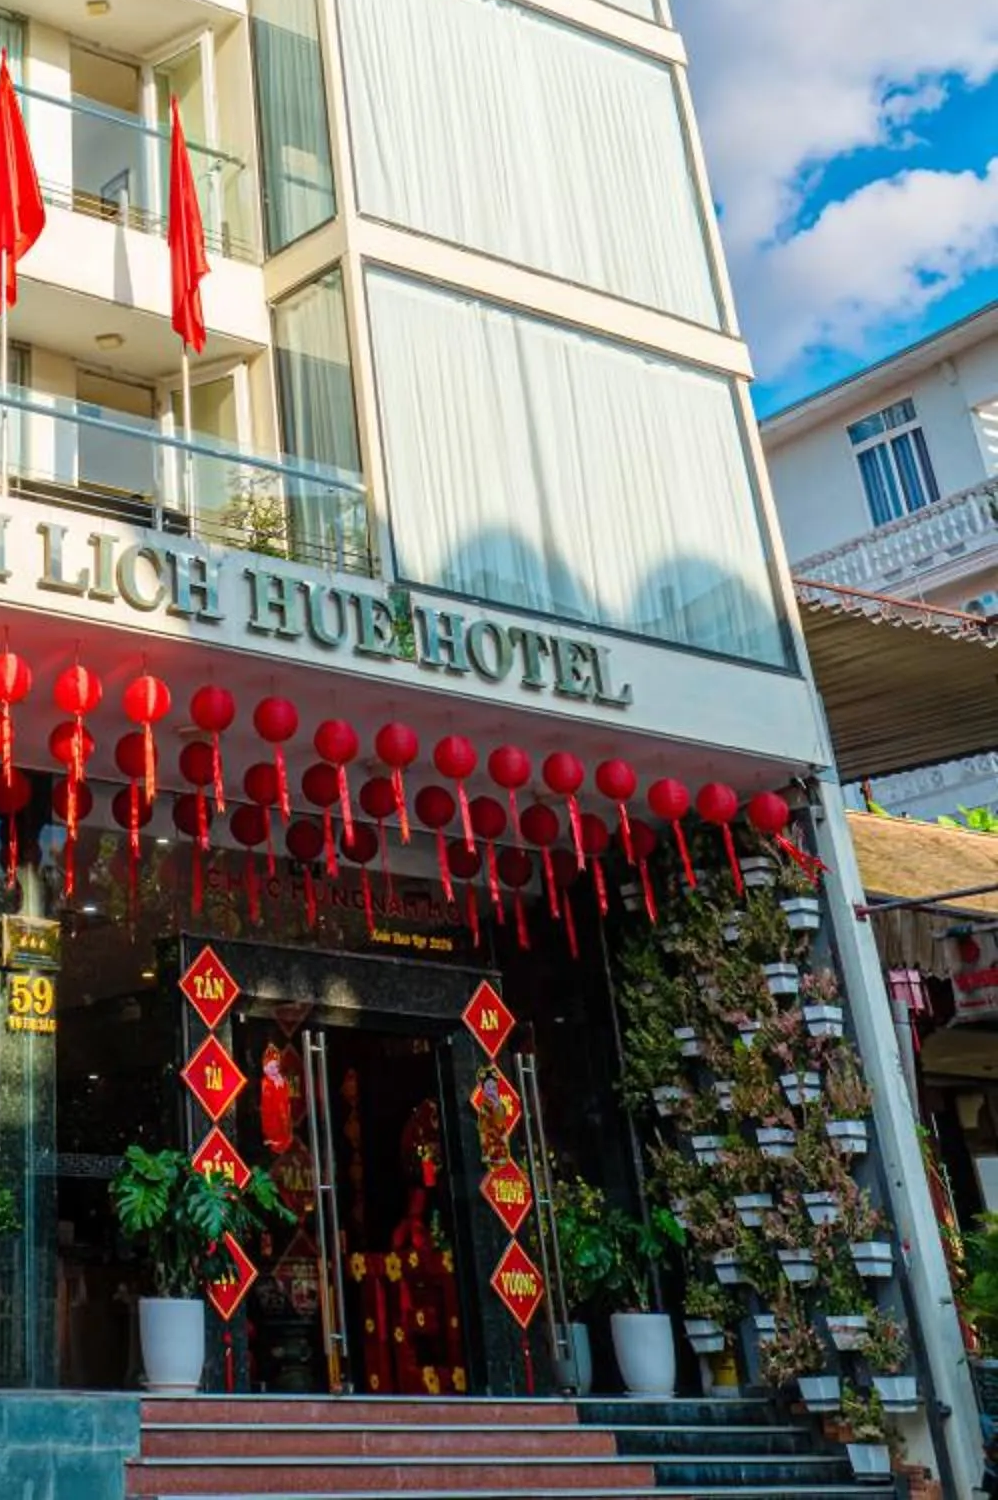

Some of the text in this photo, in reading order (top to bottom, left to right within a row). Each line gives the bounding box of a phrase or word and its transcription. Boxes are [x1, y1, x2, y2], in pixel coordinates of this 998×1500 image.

[36, 520, 226, 621] LICH
[243, 565, 403, 662] HUE
[414, 604, 634, 709] HOTEL
[11, 975, 54, 1015] 59
[193, 967, 224, 1000] TẤN
[480, 1009, 499, 1030] AN
[204, 1061, 223, 1091] TÀI
